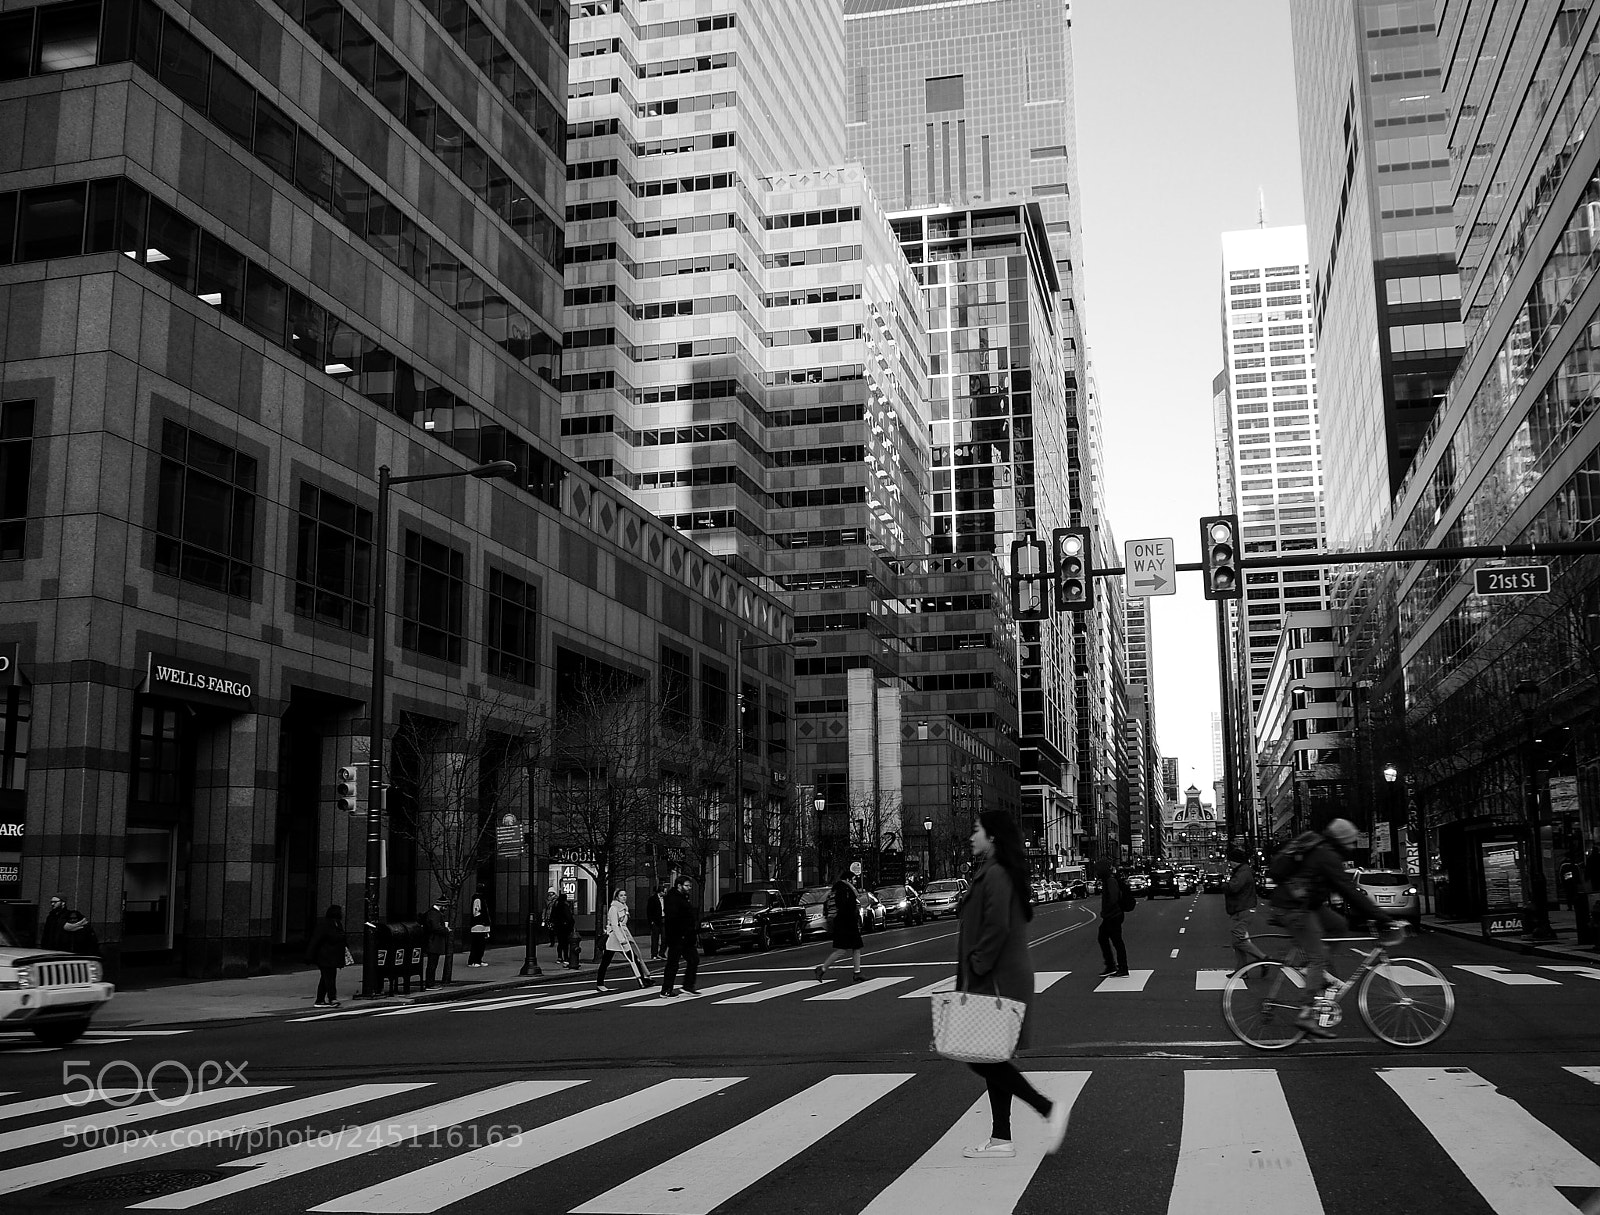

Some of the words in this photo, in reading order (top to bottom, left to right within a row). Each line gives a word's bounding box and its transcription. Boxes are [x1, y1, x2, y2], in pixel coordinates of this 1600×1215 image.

[1135, 543, 1164, 557] ONE
[1134, 558, 1166, 572] WAY
[1488, 573, 1518, 589] 21st
[1521, 572, 1536, 588] St
[156, 665, 206, 689] WELLS
[208, 676, 251, 698] FARGO
[0, 823, 25, 836] ARG
[558, 847, 597, 862] Mobil
[1490, 920, 1504, 929] AL
